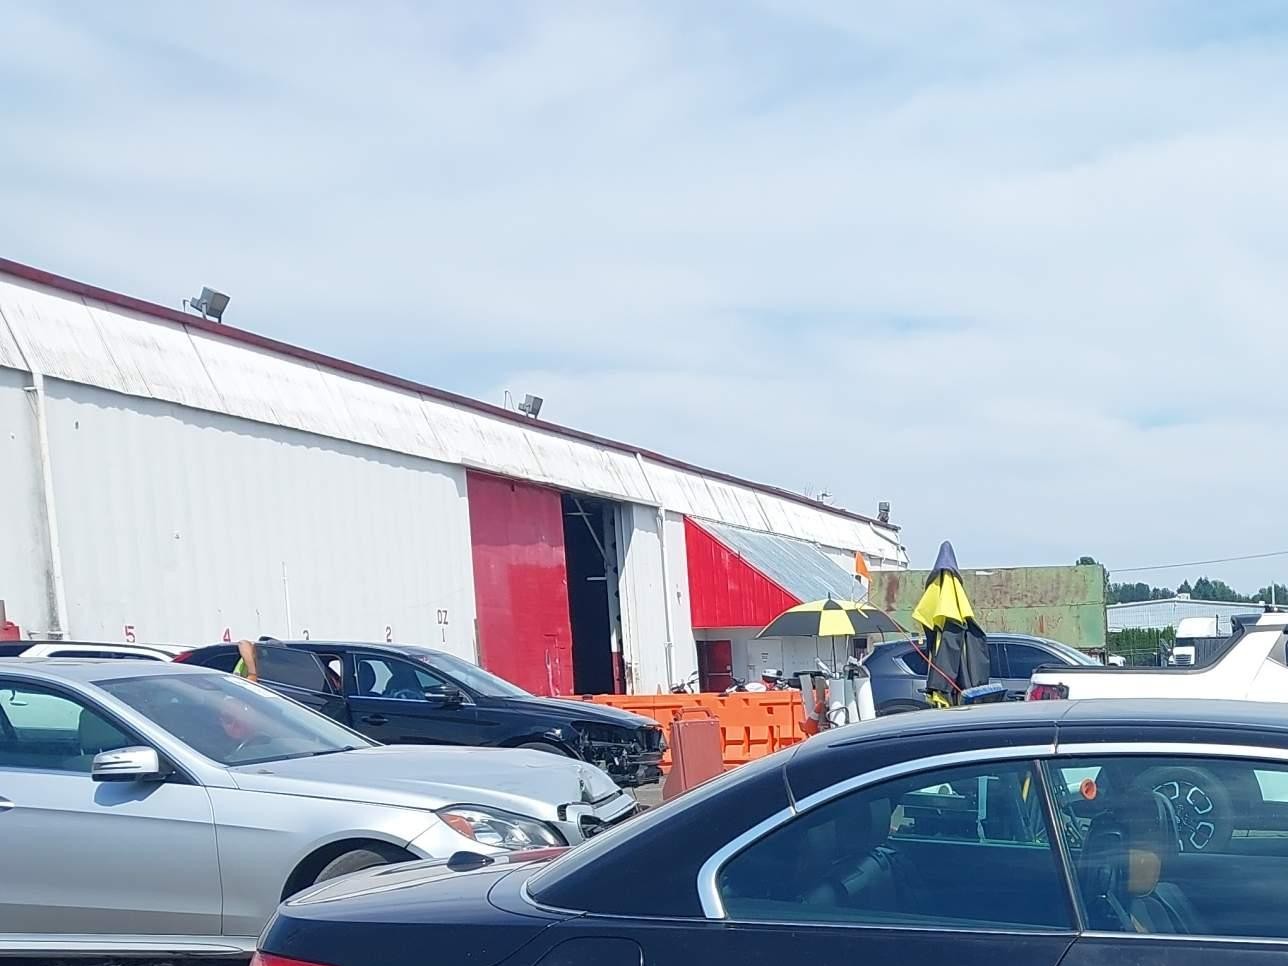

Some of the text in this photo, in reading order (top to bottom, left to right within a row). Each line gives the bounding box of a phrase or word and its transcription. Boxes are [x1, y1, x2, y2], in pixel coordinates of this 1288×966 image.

[124, 625, 136, 643] 5
[222, 628, 231, 642] 4
[385, 626, 393, 643] 2
